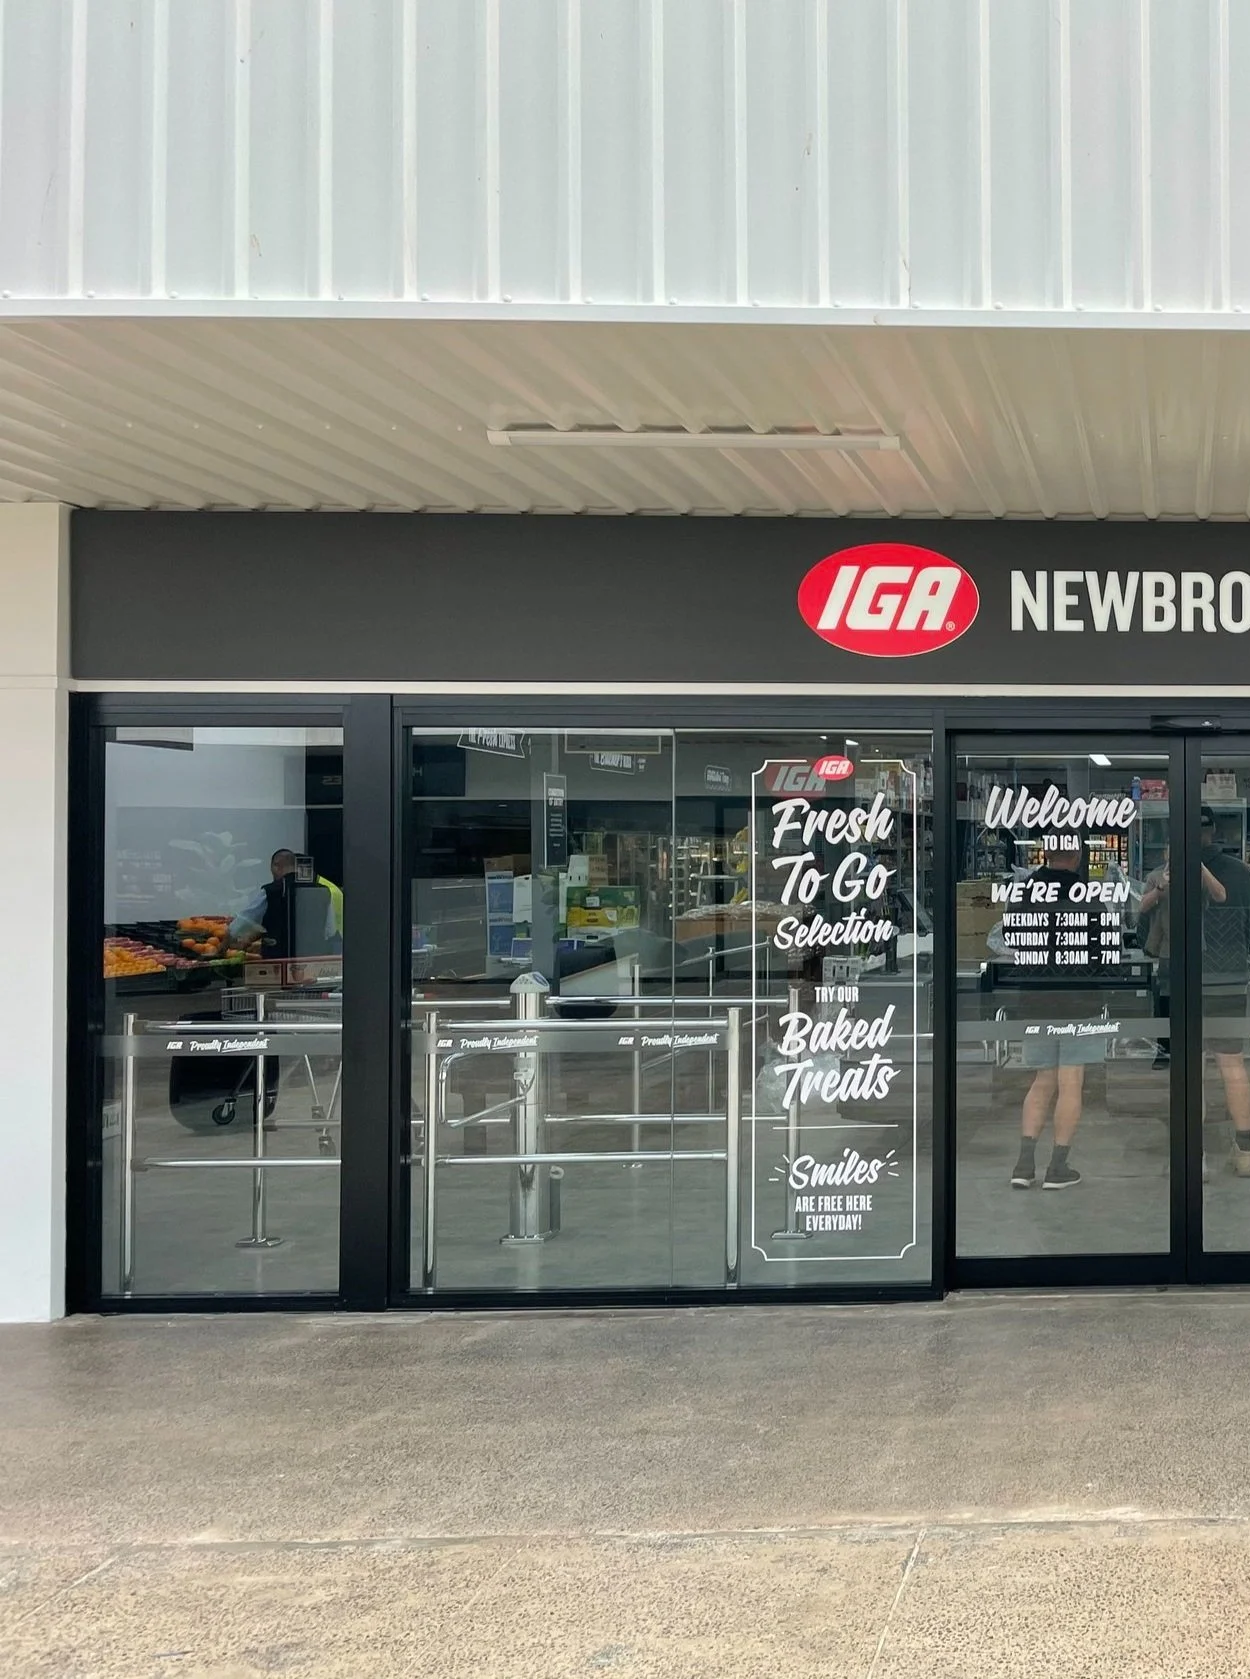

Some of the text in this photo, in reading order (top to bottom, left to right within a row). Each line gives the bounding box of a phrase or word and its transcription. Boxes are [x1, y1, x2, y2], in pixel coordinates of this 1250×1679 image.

[815, 565, 963, 631] IGA
[818, 760, 851, 774] IGA
[984, 784, 1137, 829] Welcome
[772, 792, 894, 849] Fresh
[1043, 835, 1080, 850] TO IGA
[771, 851, 897, 906] To Go
[991, 879, 1131, 903] WE'RE OPEN
[773, 907, 894, 950] Selection
[1003, 912, 1049, 927] WEEKDAYS
[1055, 912, 1088, 927] 7:30AM
[1100, 912, 1120, 927] 8PM
[1004, 932, 1049, 946] SATURDAY
[1055, 932, 1088, 946] 7:30AM
[1100, 932, 1120, 946] 8PM
[1014, 951, 1049, 965] SUNDAY
[1055, 951, 1088, 965] 8:30AM
[1100, 951, 1120, 965] 7PM
[814, 986, 859, 1003] TRY OUR
[777, 1004, 896, 1056] Baked
[1025, 1021, 1121, 1036] IGA Proudly Independent
[166, 1038, 270, 1052] IGA Proudly Independent
[437, 1035, 540, 1050] IGA Proudly Independent
[618, 1032, 720, 1047] IGA Proudly Independent
[773, 1052, 901, 1110] Treats
[788, 1147, 886, 1190] Smiles
[795, 1194, 873, 1213] ARE FREE HERE
[805, 1214, 862, 1232] EVERYDAY!
